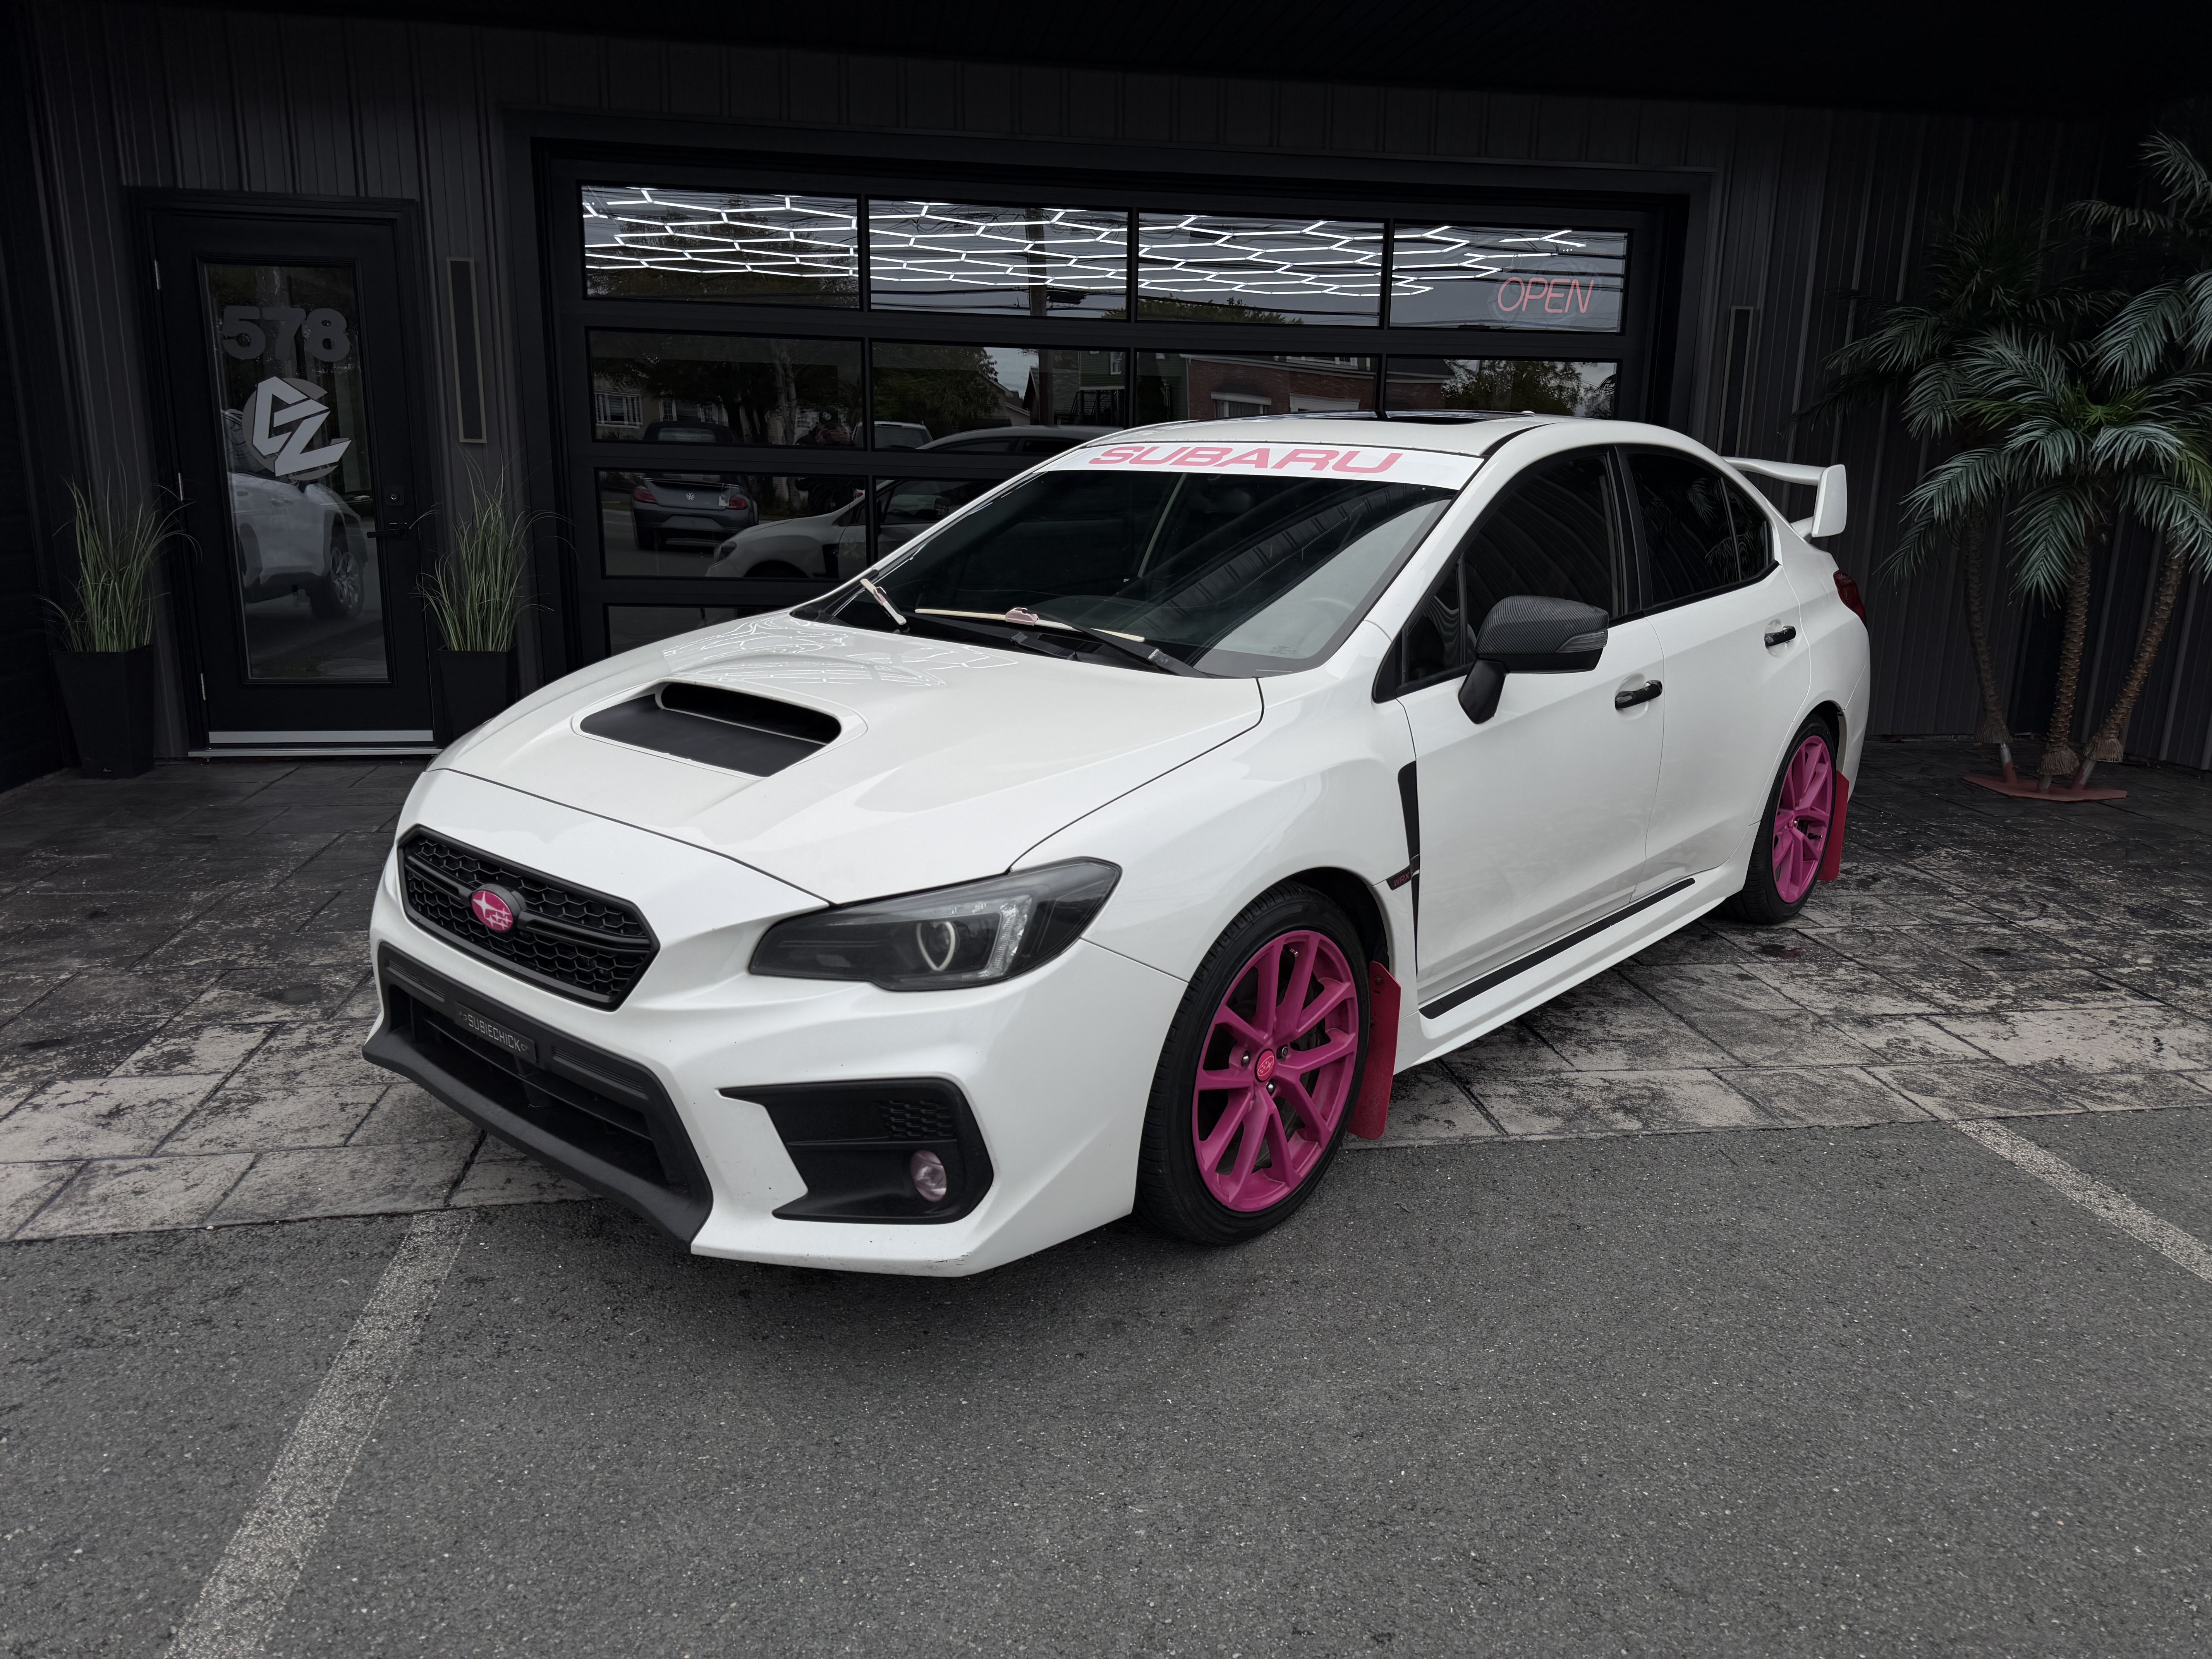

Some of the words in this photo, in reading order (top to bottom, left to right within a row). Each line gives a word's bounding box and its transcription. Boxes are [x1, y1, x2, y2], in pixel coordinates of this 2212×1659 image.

[1498, 276, 1594, 313] OPEN
[222, 306, 350, 362] 578
[1088, 446, 1403, 474] SUBARU
[1394, 872, 1410, 886] WRX
[468, 1014, 521, 1051] SUBIECHICK
